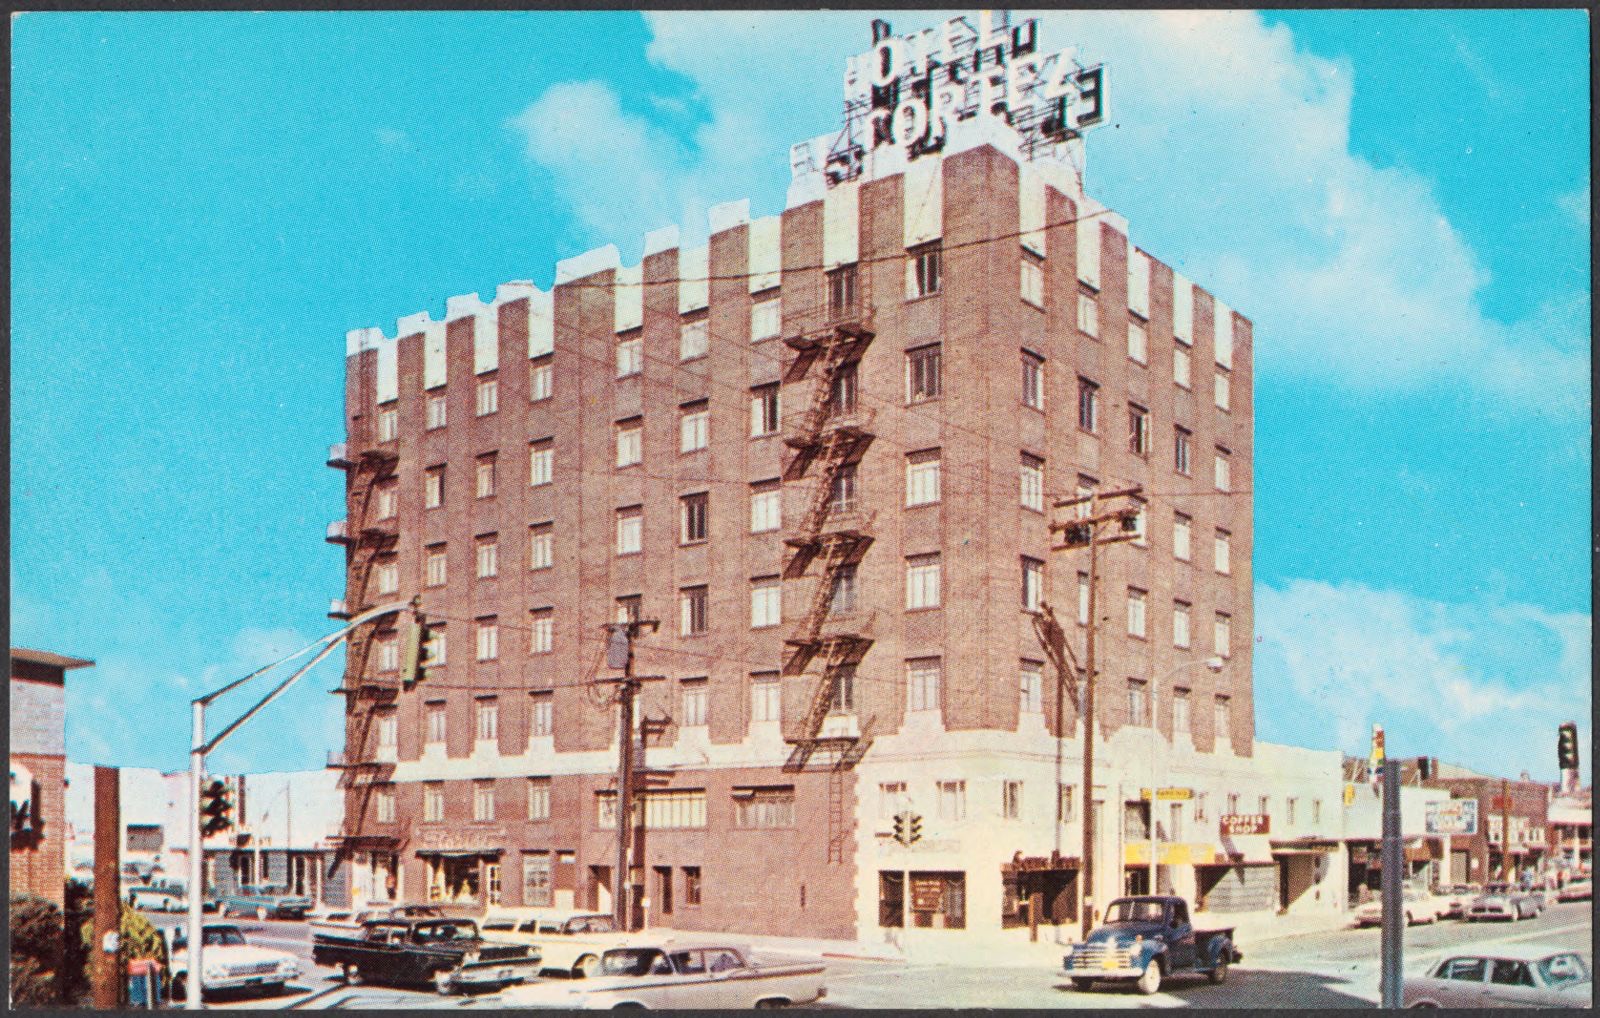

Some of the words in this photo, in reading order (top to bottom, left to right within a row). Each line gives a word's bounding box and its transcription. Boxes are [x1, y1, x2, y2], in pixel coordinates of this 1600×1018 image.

[863, 46, 1079, 155] CORTEZ
[1222, 815, 1264, 825] COFFEE
[1229, 825, 1258, 833] SHOP
